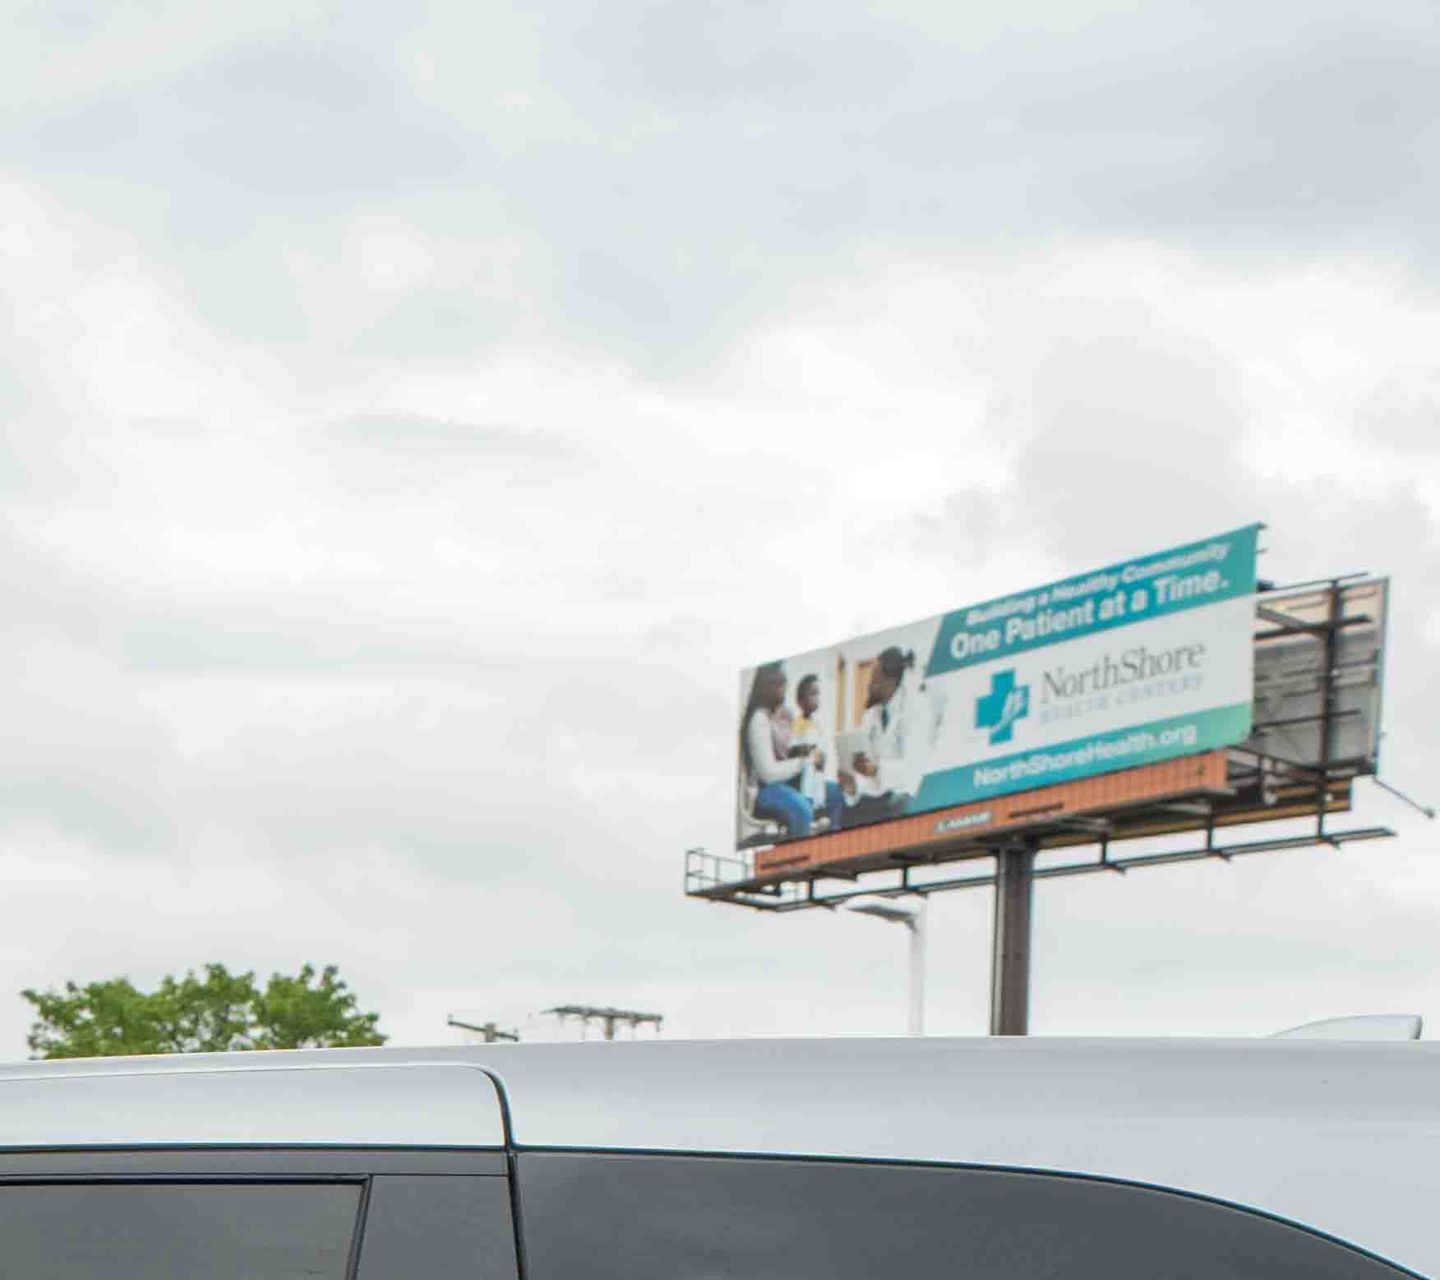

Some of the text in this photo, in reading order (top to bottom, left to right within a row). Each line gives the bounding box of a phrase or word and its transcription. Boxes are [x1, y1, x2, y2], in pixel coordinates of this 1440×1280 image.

[951, 570, 1229, 659] One Patient at a Time.
[967, 597, 1036, 625] Building
[1053, 571, 1119, 600] Healthy
[1122, 544, 1229, 583] Community
[1042, 643, 1205, 703] NorthShore
[974, 726, 1196, 786] NorthShoreHealth.org
